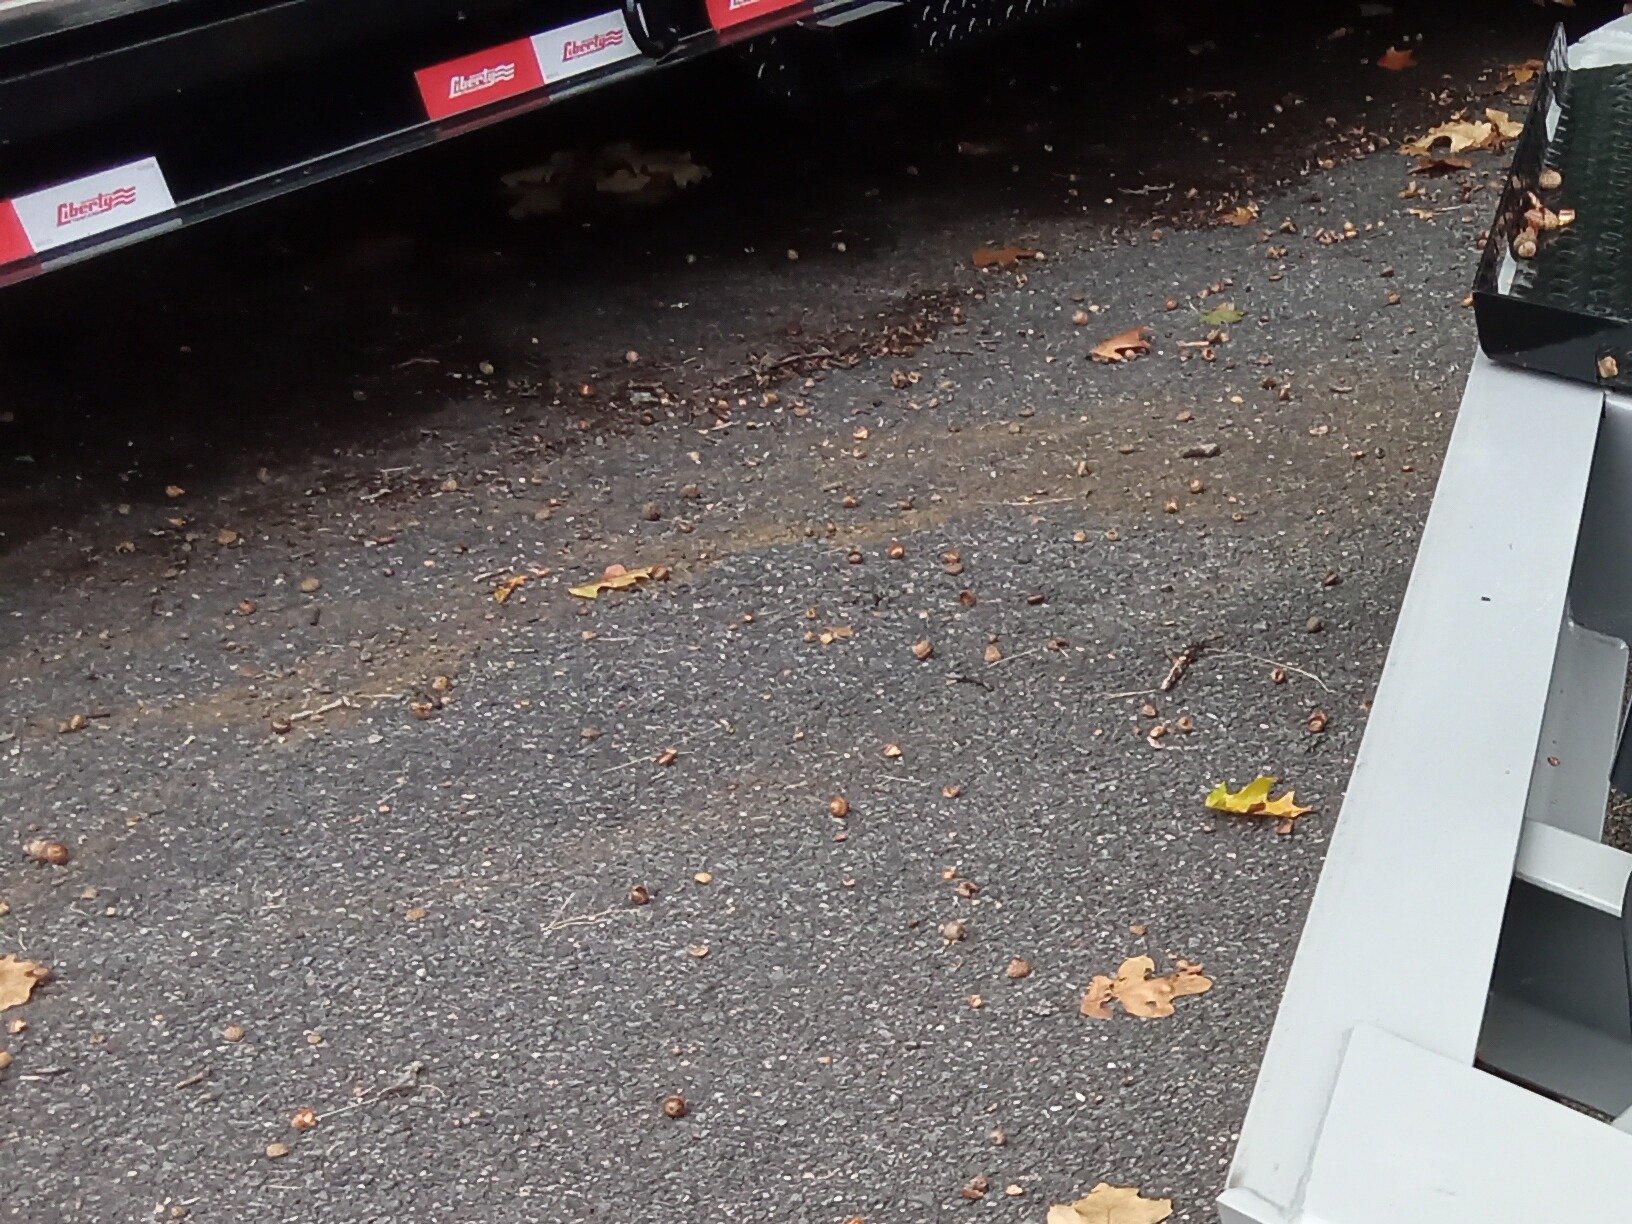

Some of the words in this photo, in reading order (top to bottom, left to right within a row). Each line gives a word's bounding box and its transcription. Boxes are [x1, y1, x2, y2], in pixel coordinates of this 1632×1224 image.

[562, 34, 606, 63] Liberty
[448, 68, 498, 99] Liberty
[56, 192, 114, 227] Liberty
